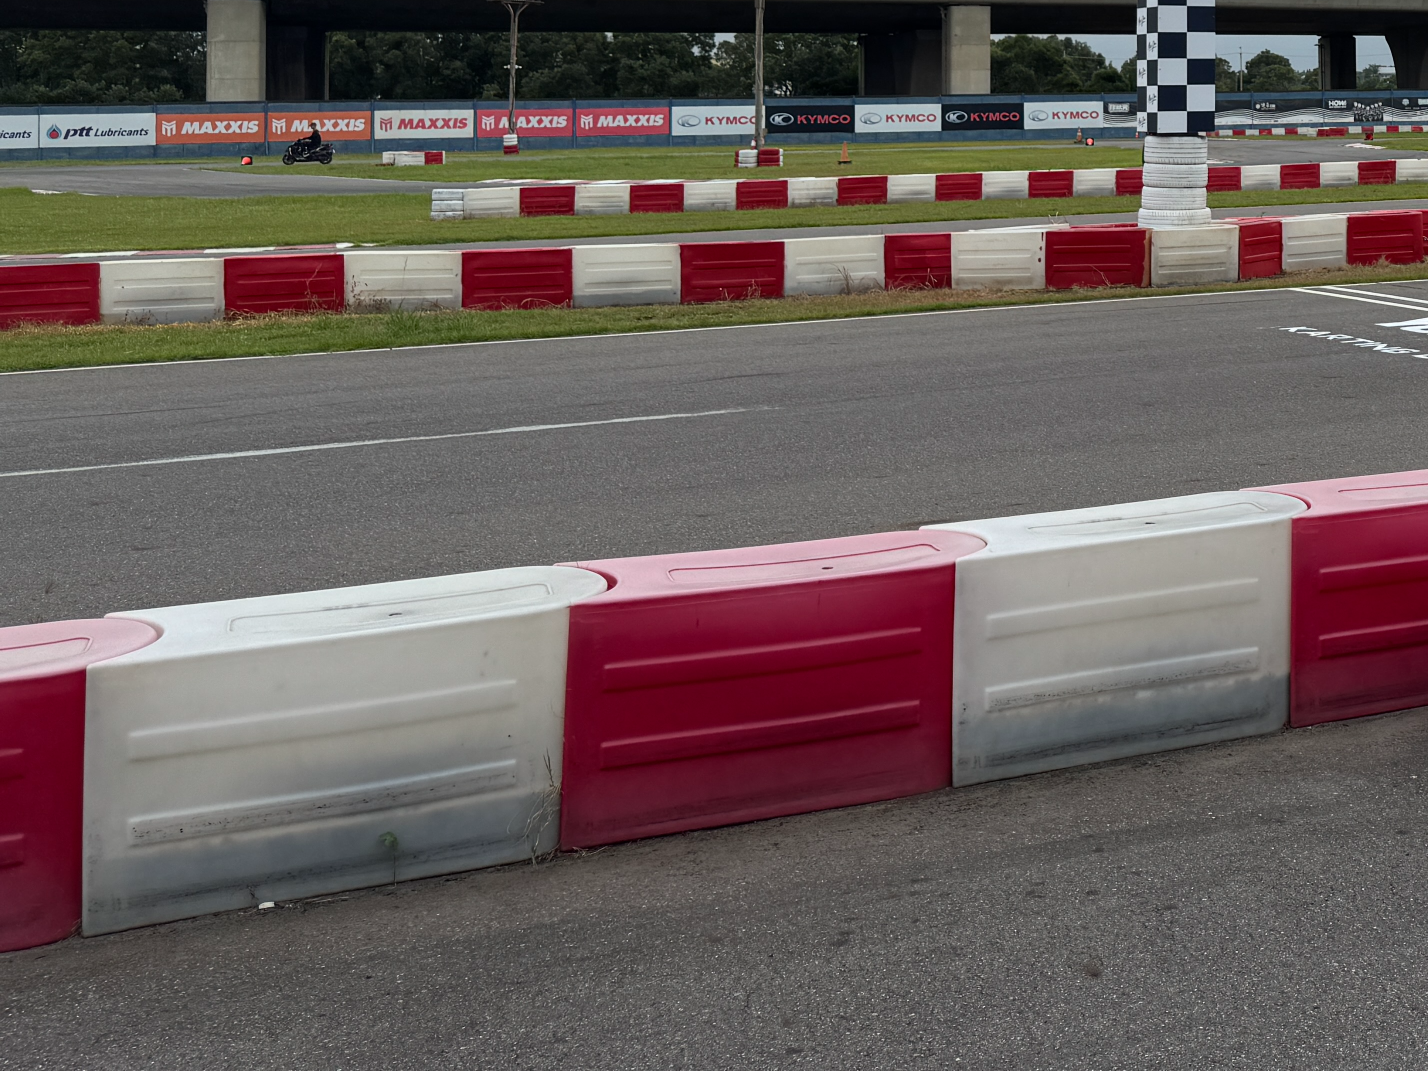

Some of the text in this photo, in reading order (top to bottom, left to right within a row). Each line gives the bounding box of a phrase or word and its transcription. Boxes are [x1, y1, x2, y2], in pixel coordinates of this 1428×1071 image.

[597, 114, 664, 127] MAXXIS
[705, 115, 756, 126] KYMCO
[797, 114, 851, 125] KYMCO
[885, 113, 937, 123] KYMCO
[970, 112, 1020, 122] KYMCO
[1052, 110, 1099, 120] KYMCO
[181, 120, 259, 135] MAXXIS
[291, 118, 365, 132] MAXXIS
[397, 117, 468, 130] MAXXIS
[0, 129, 32, 139] icants
[63, 126, 149, 140] ptt Lubricants
[1279, 326, 1420, 354] KARTING
